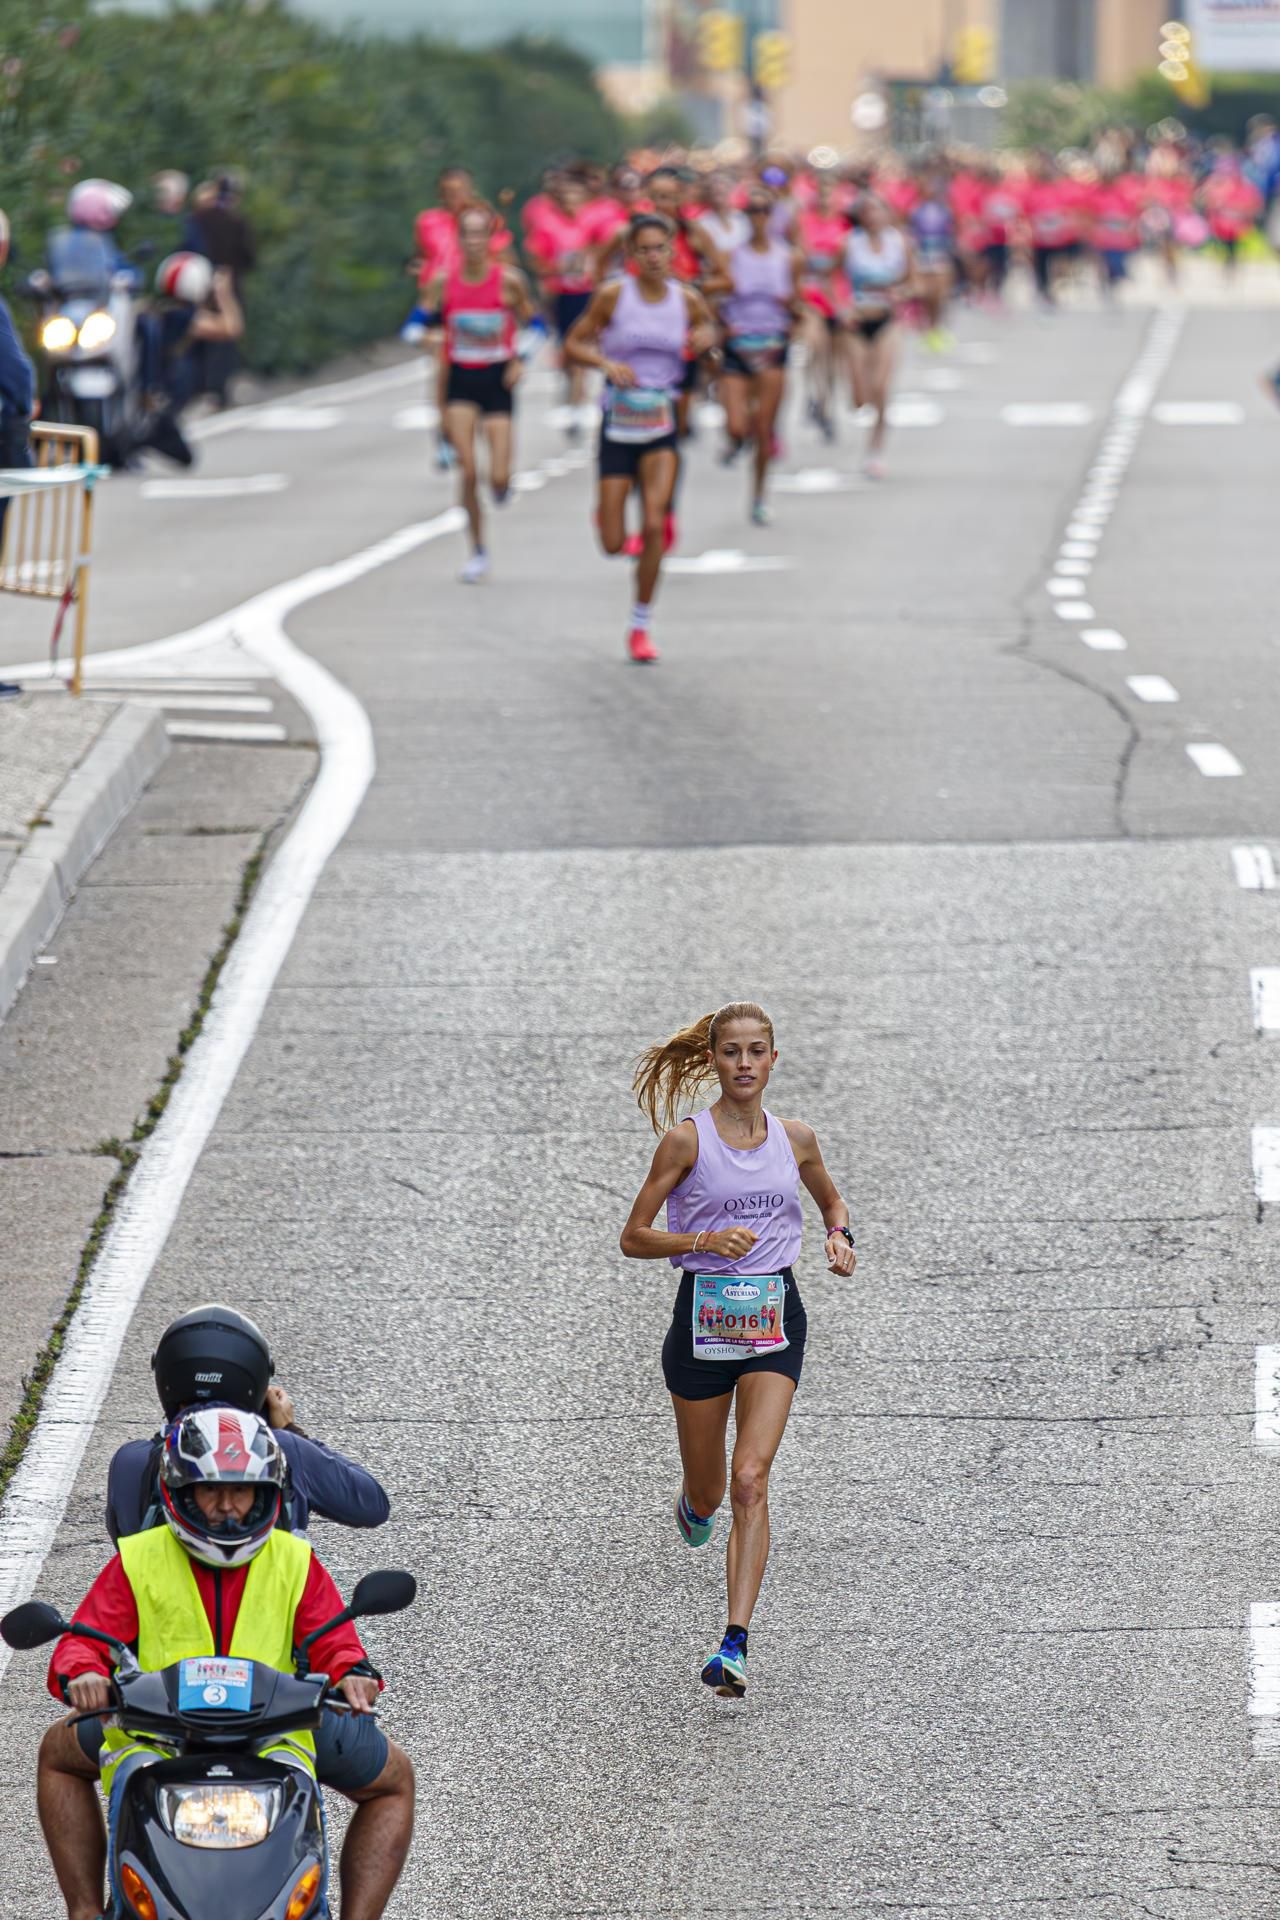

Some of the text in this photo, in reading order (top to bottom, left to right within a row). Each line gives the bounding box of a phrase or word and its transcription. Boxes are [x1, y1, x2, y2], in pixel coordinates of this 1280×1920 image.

[724, 1193, 784, 1212] OYSHO
[724, 1314, 759, 1329] 016
[704, 1347, 735, 1355] OYSHO
[209, 1686, 222, 1703] 3
